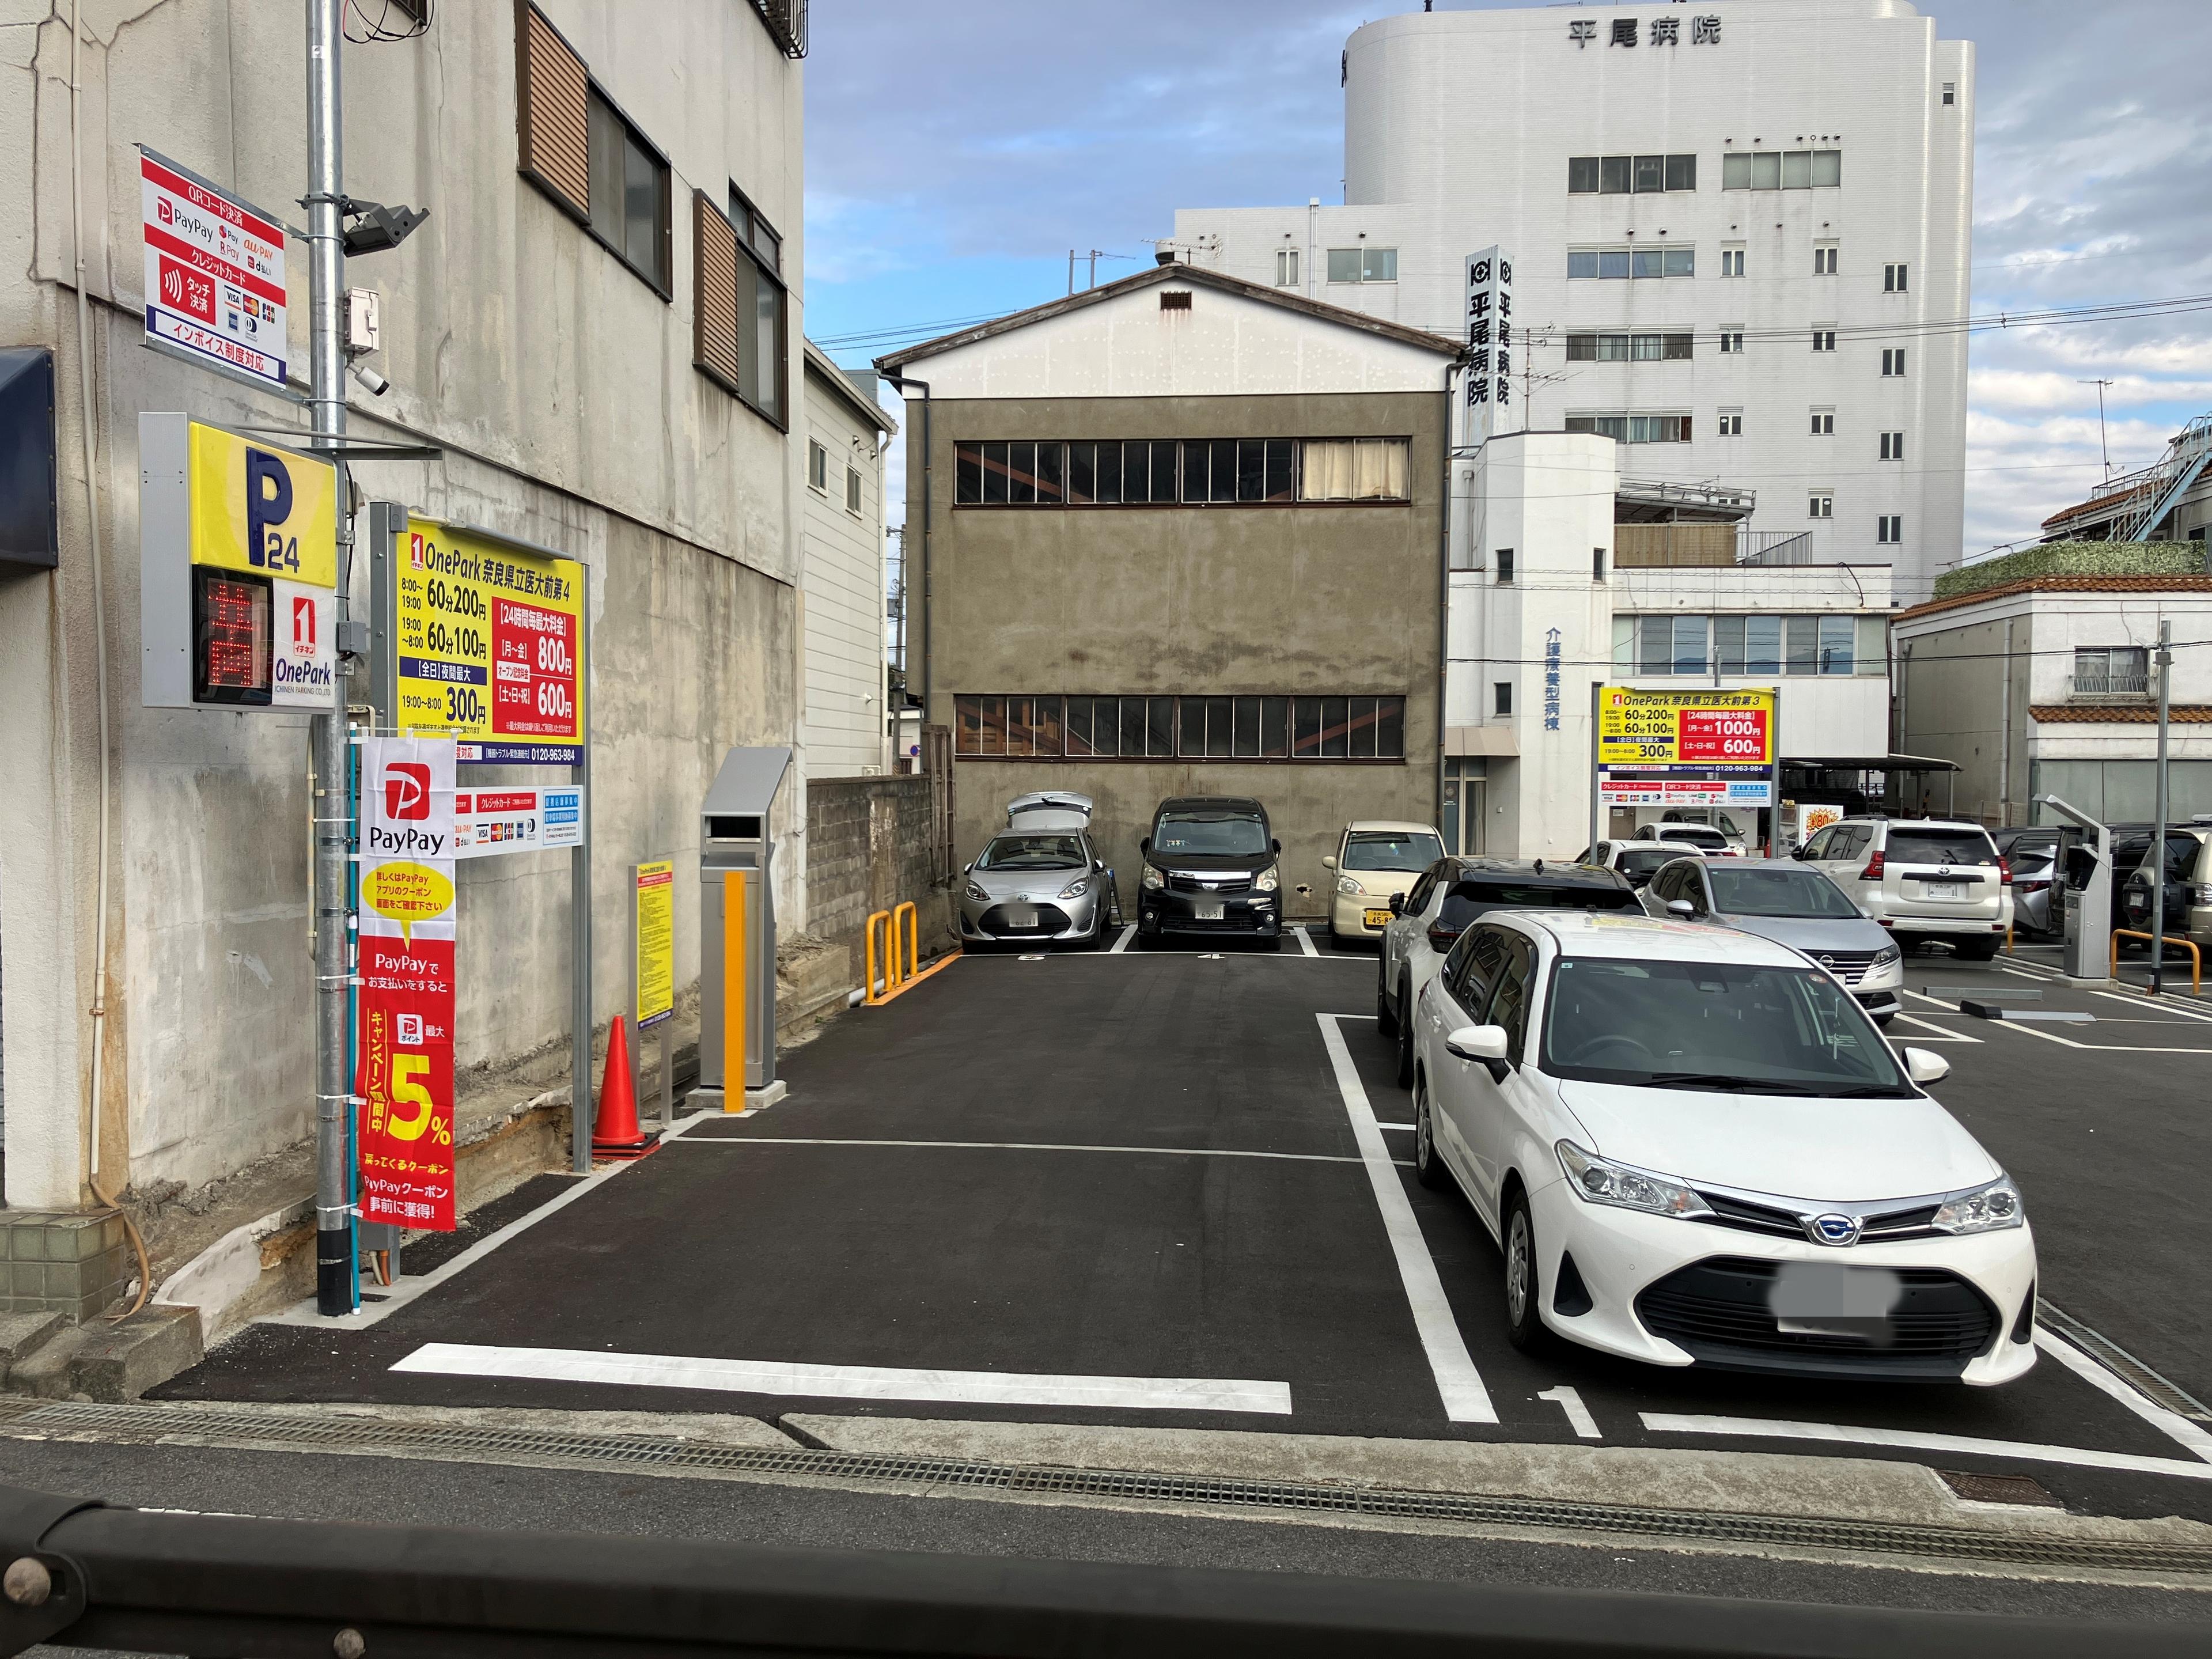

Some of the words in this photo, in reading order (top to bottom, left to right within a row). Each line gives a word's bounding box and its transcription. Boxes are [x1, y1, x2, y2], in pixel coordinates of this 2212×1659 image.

[1570, 14, 1722, 48] 平尾病院
[188, 185, 243, 226] QRコード決済
[175, 209, 213, 243] PayPay
[226, 245, 239, 261] Pay
[260, 247, 273, 261] PAY
[192, 249, 245, 285] クレジットカード
[256, 257, 271, 276] d払い
[187, 276, 210, 295] タッチ
[190, 293, 208, 314] 決済
[226, 291, 240, 304] VISA
[174, 324, 264, 372] インボイス制度対応
[1468, 290, 1491, 407] 平尾病院
[1498, 290, 1512, 406] 平尾病院
[246, 446, 293, 567] P
[268, 532, 300, 574] 24
[426, 542, 481, 581] OnePark
[482, 558, 570, 601] 奈良県立医大前第4
[402, 594, 421, 610] 19:00
[427, 578, 486, 620] 60分200円
[402, 616, 421, 631] 19:00
[295, 645, 314, 654] イチネン
[427, 622, 486, 660] 60分100円
[538, 635, 572, 675] 800円
[276, 658, 331, 685] OnePark
[275, 685, 294, 693] ICHINEN
[295, 687, 315, 695] PARKING
[538, 681, 572, 718] 600円
[446, 686, 486, 725] 300円
[1623, 695, 1671, 706] OnePark
[1671, 695, 1760, 706] 奈良県立医大前第3
[1624, 710, 1674, 720] 60分200円
[1624, 723, 1674, 734] 60分100円
[1714, 721, 1760, 736] 1000円
[531, 748, 575, 761] 0120-963-984
[1639, 744, 1672, 757] 300円
[1724, 739, 1760, 754] 600円
[482, 797, 510, 809] クレジットカード
[463, 824, 472, 833] PAY
[478, 829, 488, 838] VISA
[370, 827, 444, 855] PayPay
[376, 871, 429, 885] 詳しくはPayPay
[376, 886, 431, 897] アプリのクーポン
[376, 899, 442, 911] 画面をご確認下さい
[375, 953, 438, 975] PayPayで
[368, 976, 448, 993] お支払いをすると
[402, 1035, 420, 1043] ポイント
[425, 1025, 445, 1038] 最大
[369, 1011, 384, 1132] キャンペーン期間中
[364, 1153, 449, 1175] 戻ってくるクーポン
[364, 1175, 449, 1199] PayPayクーポン
[1537, 1385, 1603, 1438] 1
